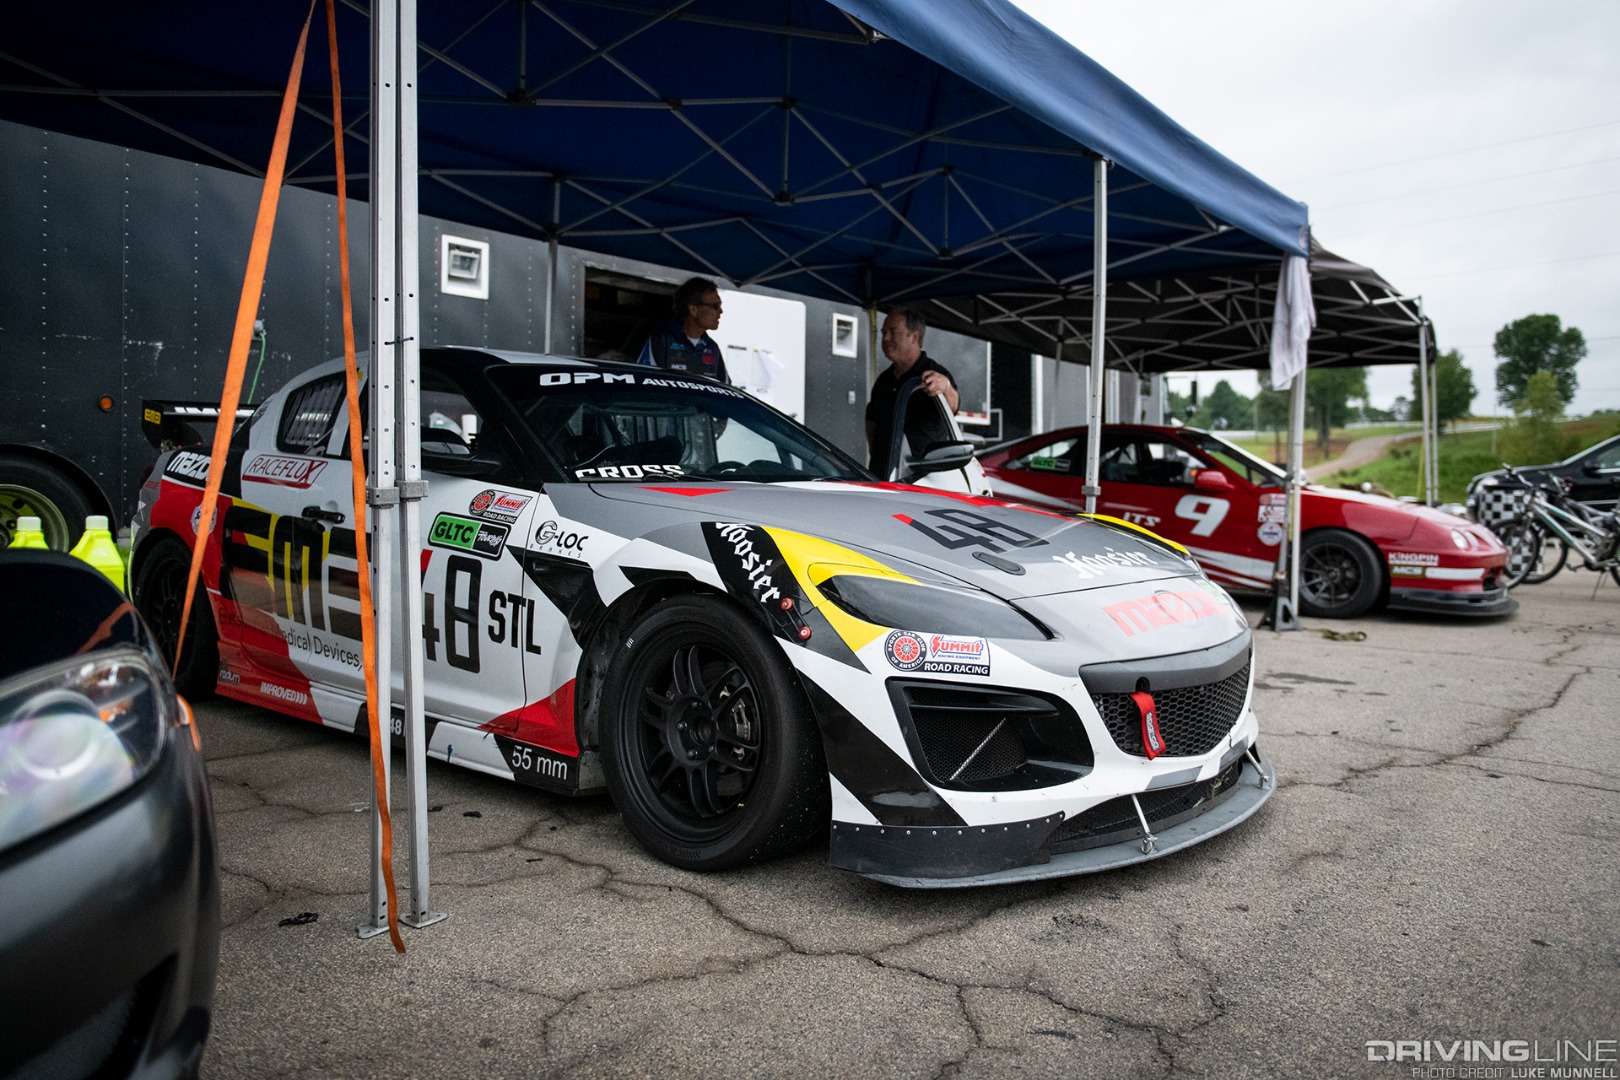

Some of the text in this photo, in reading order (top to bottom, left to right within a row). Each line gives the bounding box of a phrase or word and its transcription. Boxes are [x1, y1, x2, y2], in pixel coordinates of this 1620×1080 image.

[540, 372, 744, 399] OPM AUTOSPORTS
[248, 457, 325, 484] RACEFLUX
[575, 464, 685, 480] CROSS
[482, 511, 497, 519] ROAD
[1123, 511, 1161, 527] ITS
[1174, 494, 1231, 537] 9
[434, 521, 474, 544] GLTC
[535, 520, 589, 552] G-LOC
[889, 508, 1050, 554] 48
[715, 522, 780, 603] Hoosier
[1052, 546, 1158, 579] Hoosier
[488, 589, 541, 656] STL
[282, 622, 363, 672] edical Devices,
[899, 656, 924, 669] AMERICA
[924, 662, 989, 675] ROAD RACING
[512, 746, 568, 780] 55 mm
